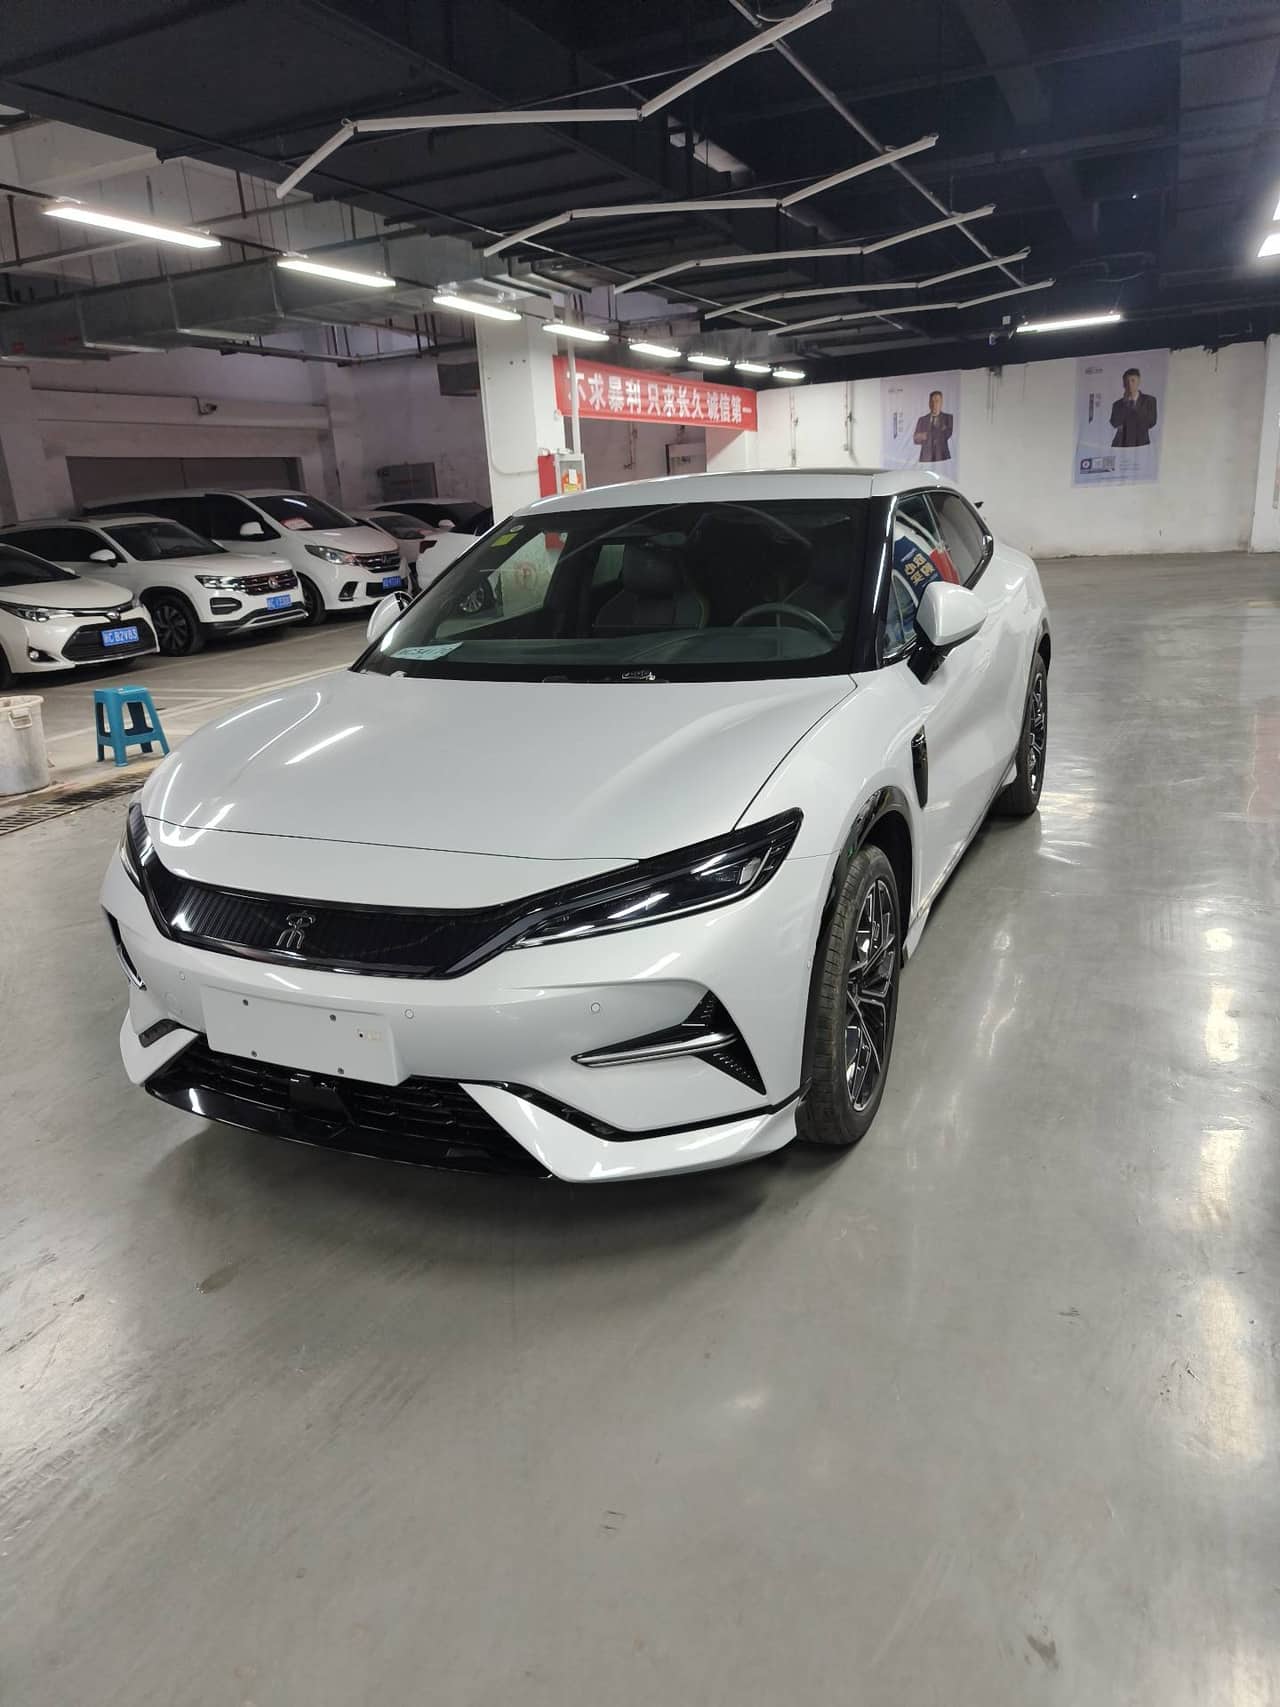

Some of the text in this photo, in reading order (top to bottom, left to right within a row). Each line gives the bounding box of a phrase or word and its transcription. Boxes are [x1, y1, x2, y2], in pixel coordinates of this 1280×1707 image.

[567, 371, 752, 424] 不求暴利 只求长久 诚信第一
